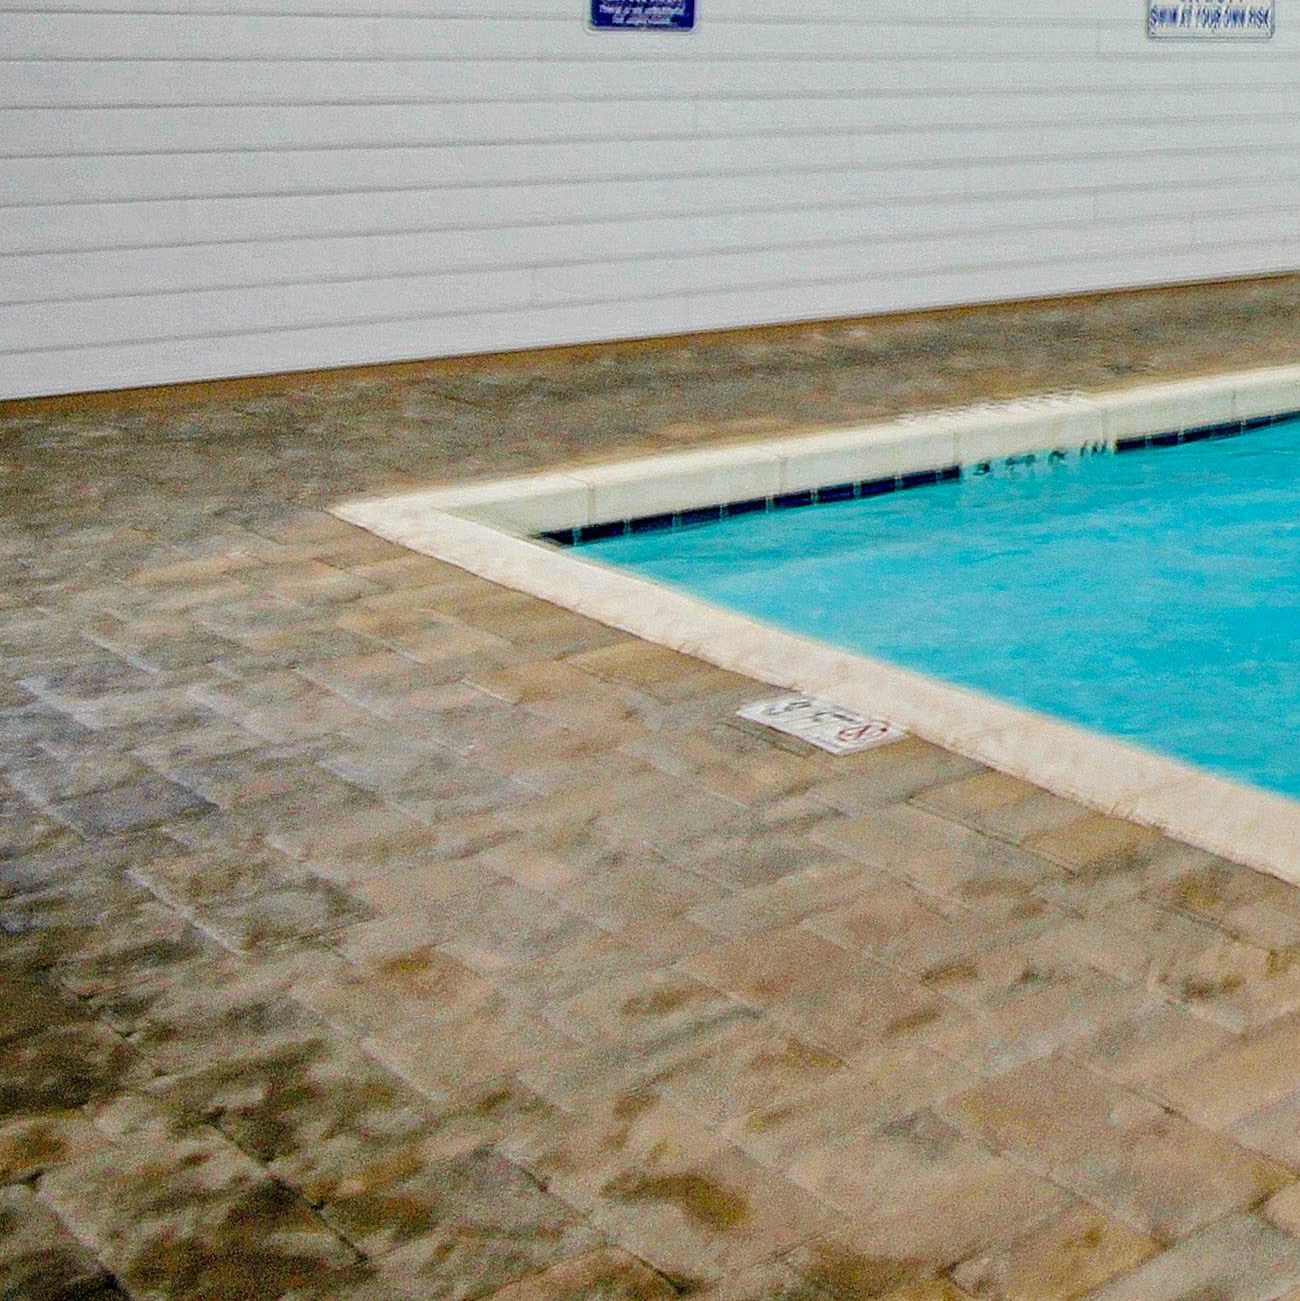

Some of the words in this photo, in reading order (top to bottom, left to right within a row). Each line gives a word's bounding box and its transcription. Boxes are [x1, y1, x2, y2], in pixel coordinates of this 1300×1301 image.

[1150, 5, 1178, 27] SWIM
[1180, 6, 1193, 27] AT
[1195, 6, 1221, 28] YOUR
[1223, 6, 1246, 28] OWN
[1247, 7, 1271, 29] RISK
